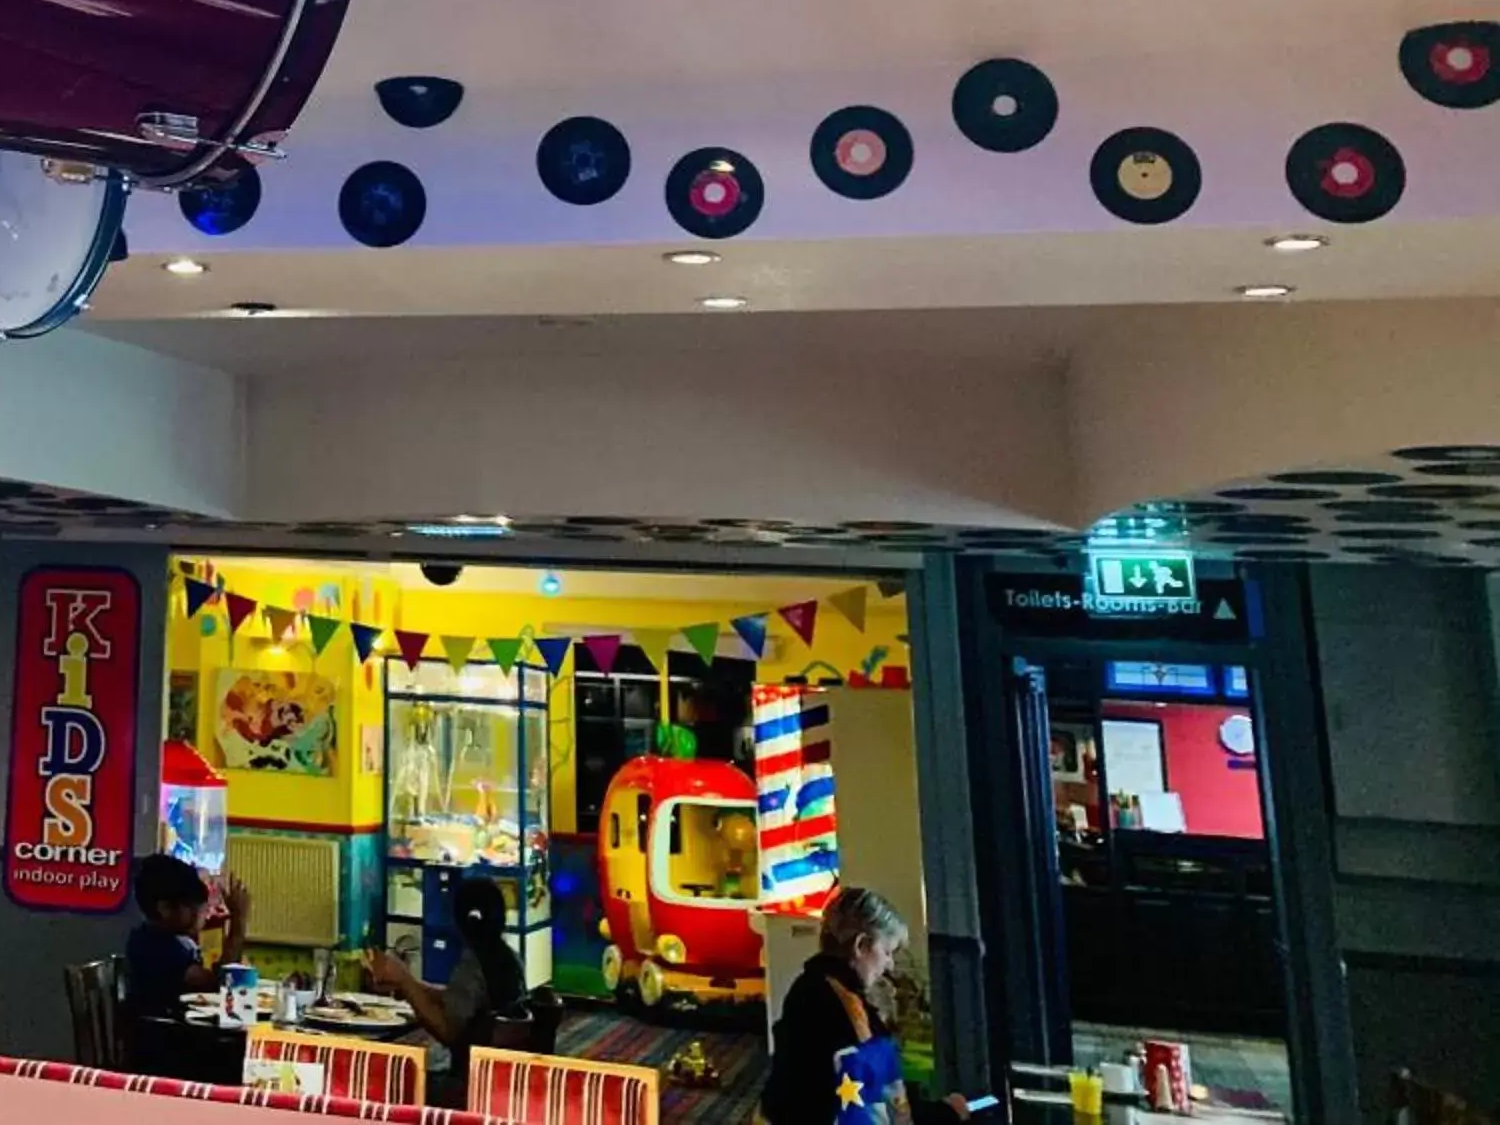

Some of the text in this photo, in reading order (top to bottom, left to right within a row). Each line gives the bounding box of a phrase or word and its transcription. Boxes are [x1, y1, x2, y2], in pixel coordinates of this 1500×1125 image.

[14, 841, 123, 866] corner
[13, 866, 120, 891] indoor play
